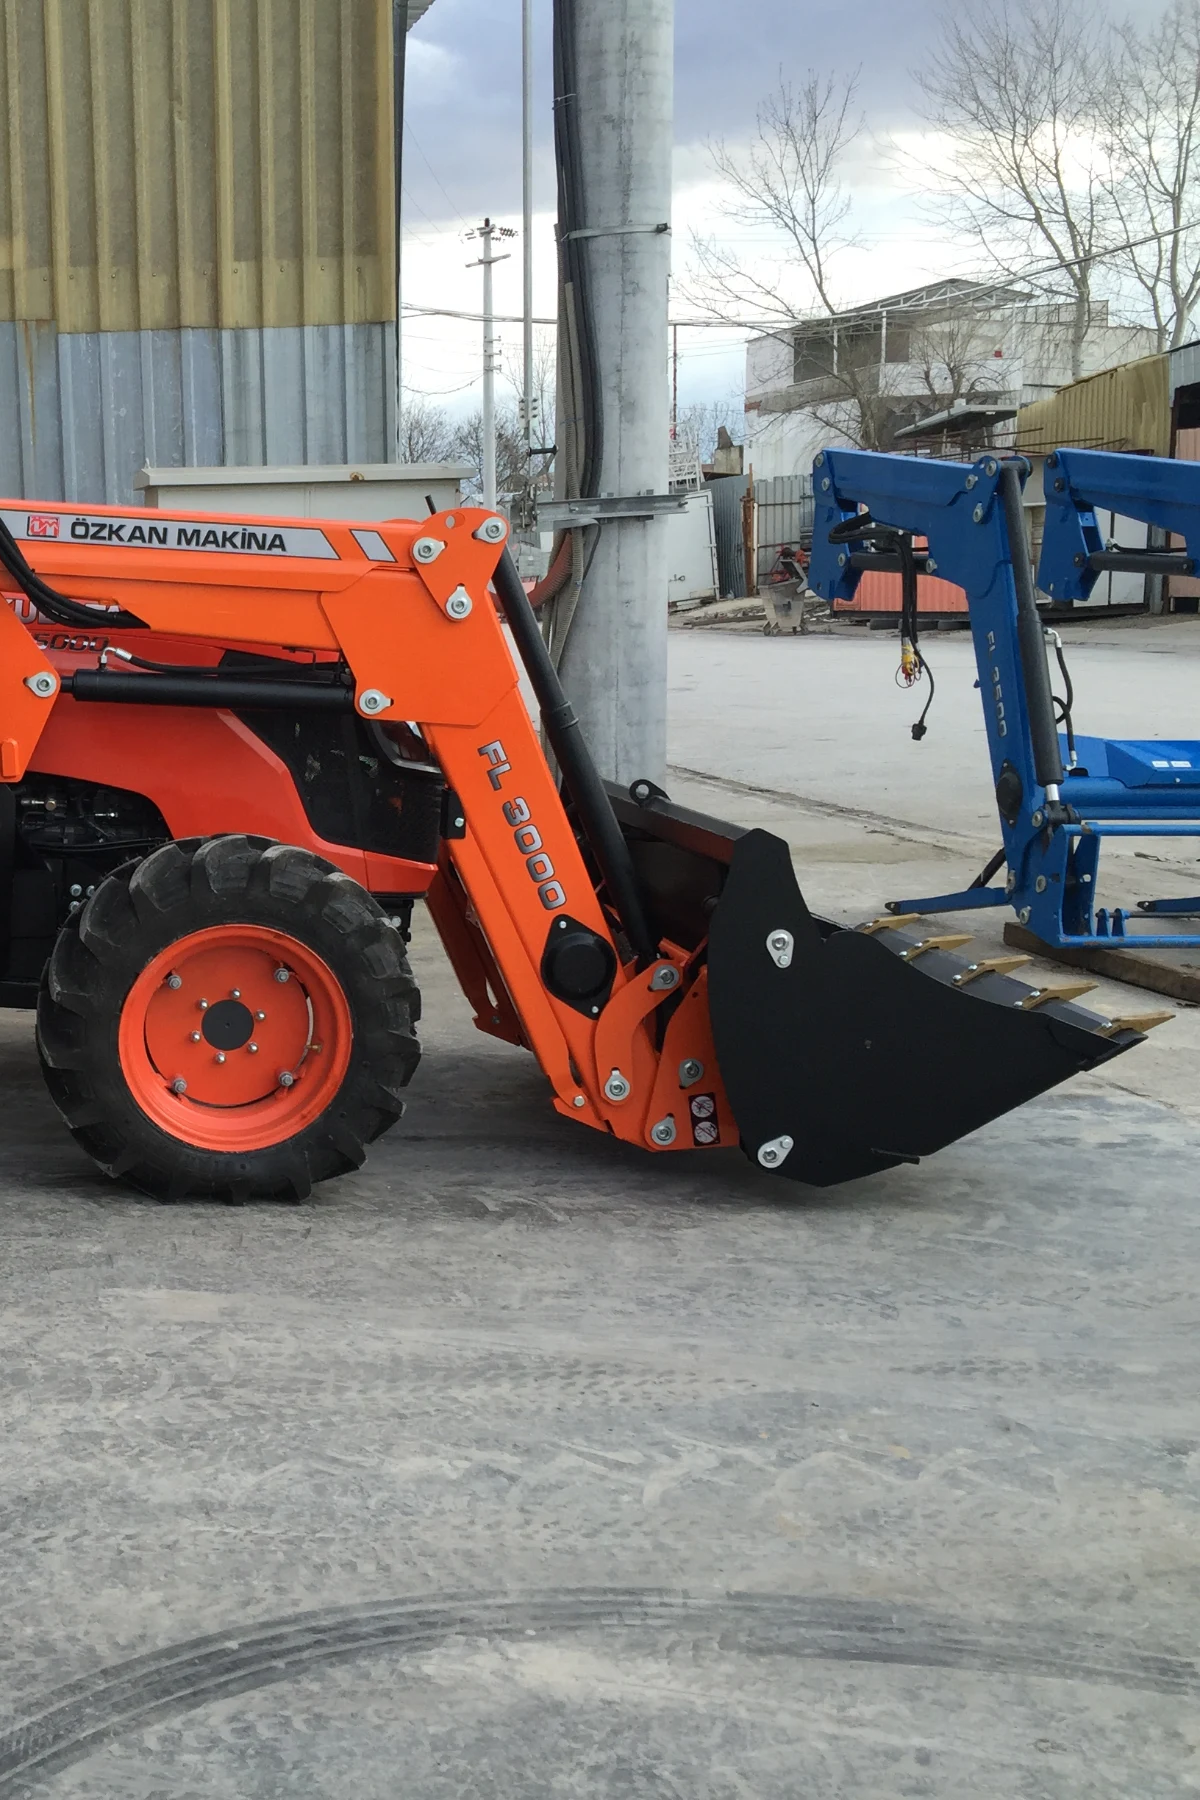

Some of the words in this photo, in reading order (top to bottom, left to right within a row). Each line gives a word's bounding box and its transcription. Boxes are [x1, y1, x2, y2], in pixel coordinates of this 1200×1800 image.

[70, 518, 168, 545] ÖZKAN
[176, 528, 287, 552] MAKİNA
[992, 666, 1007, 737] 3500
[477, 739, 512, 791] FL
[502, 796, 567, 911] 3000
